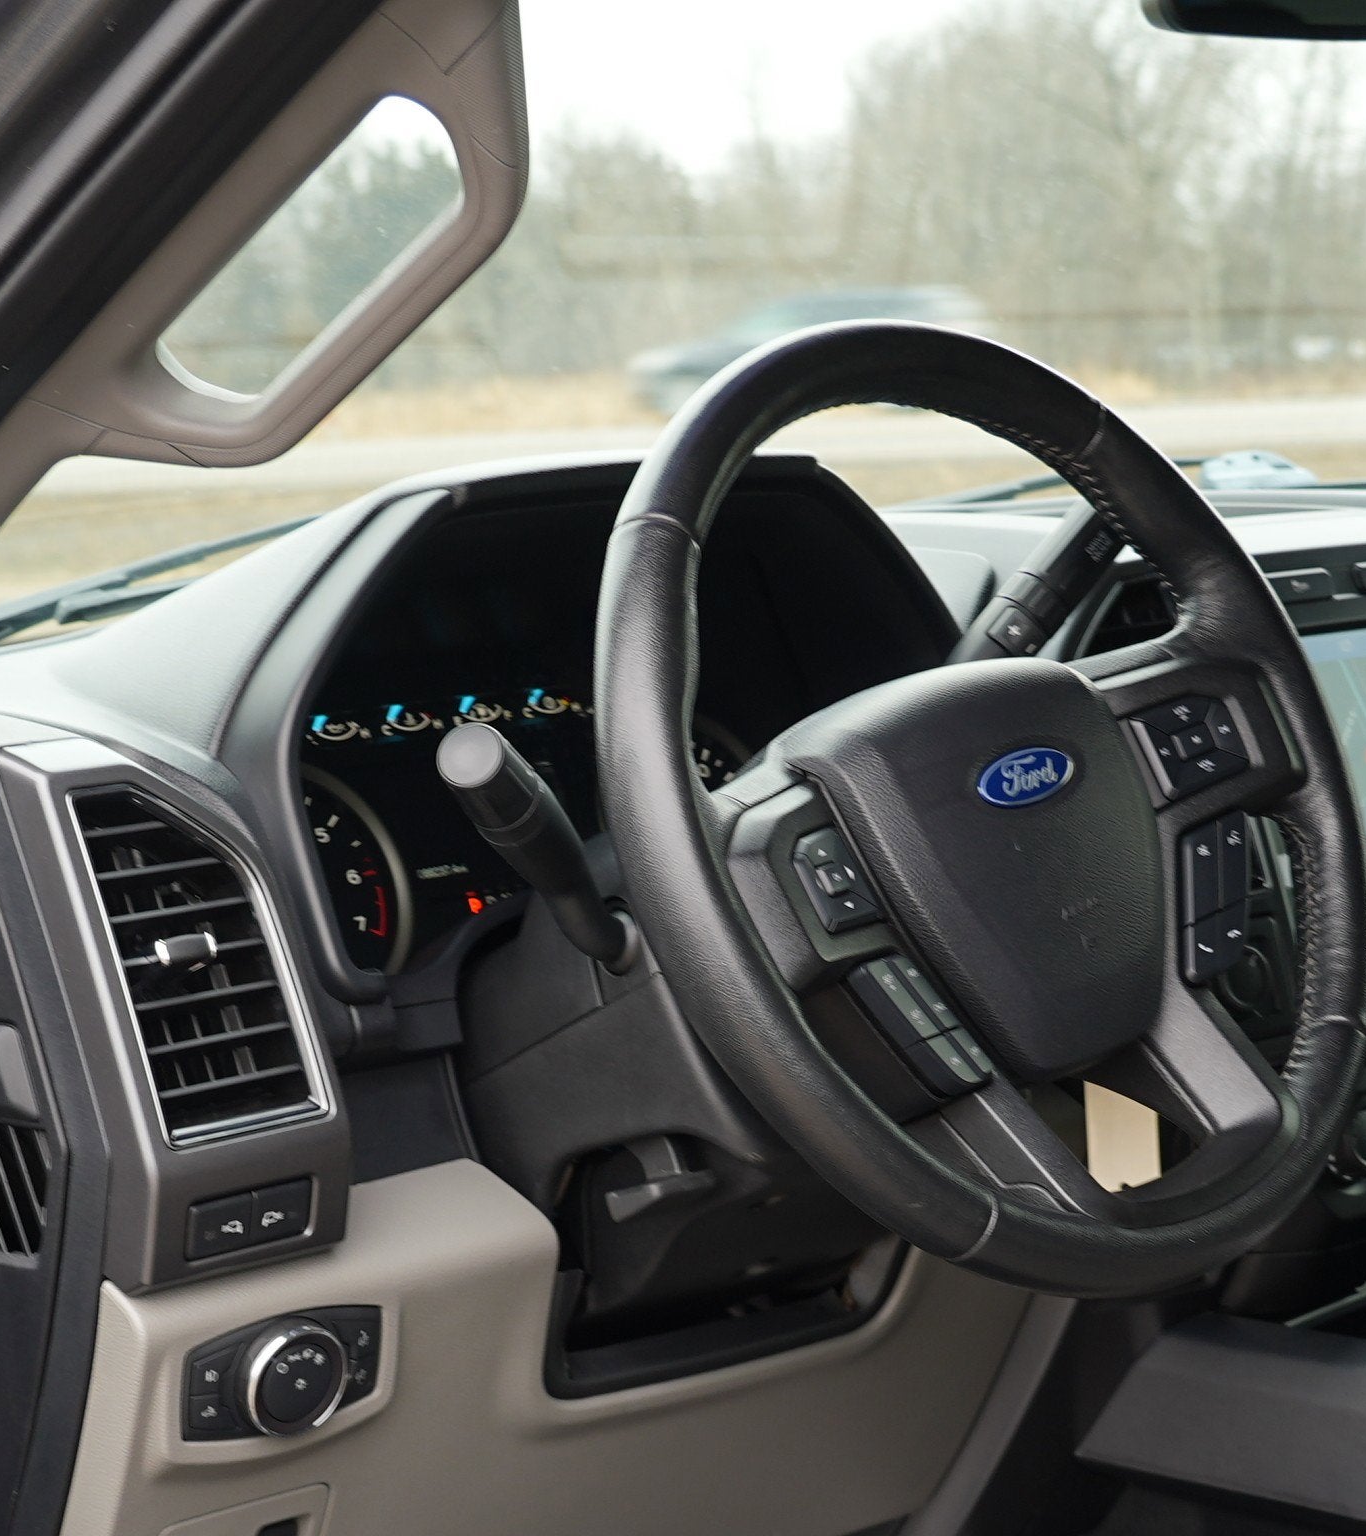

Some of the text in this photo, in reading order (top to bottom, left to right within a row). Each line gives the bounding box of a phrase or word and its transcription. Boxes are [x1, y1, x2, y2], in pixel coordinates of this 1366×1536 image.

[1001, 755, 1059, 797] Ford
[314, 827, 331, 844] 5
[345, 869, 363, 885] 6
[352, 915, 367, 932] 7
